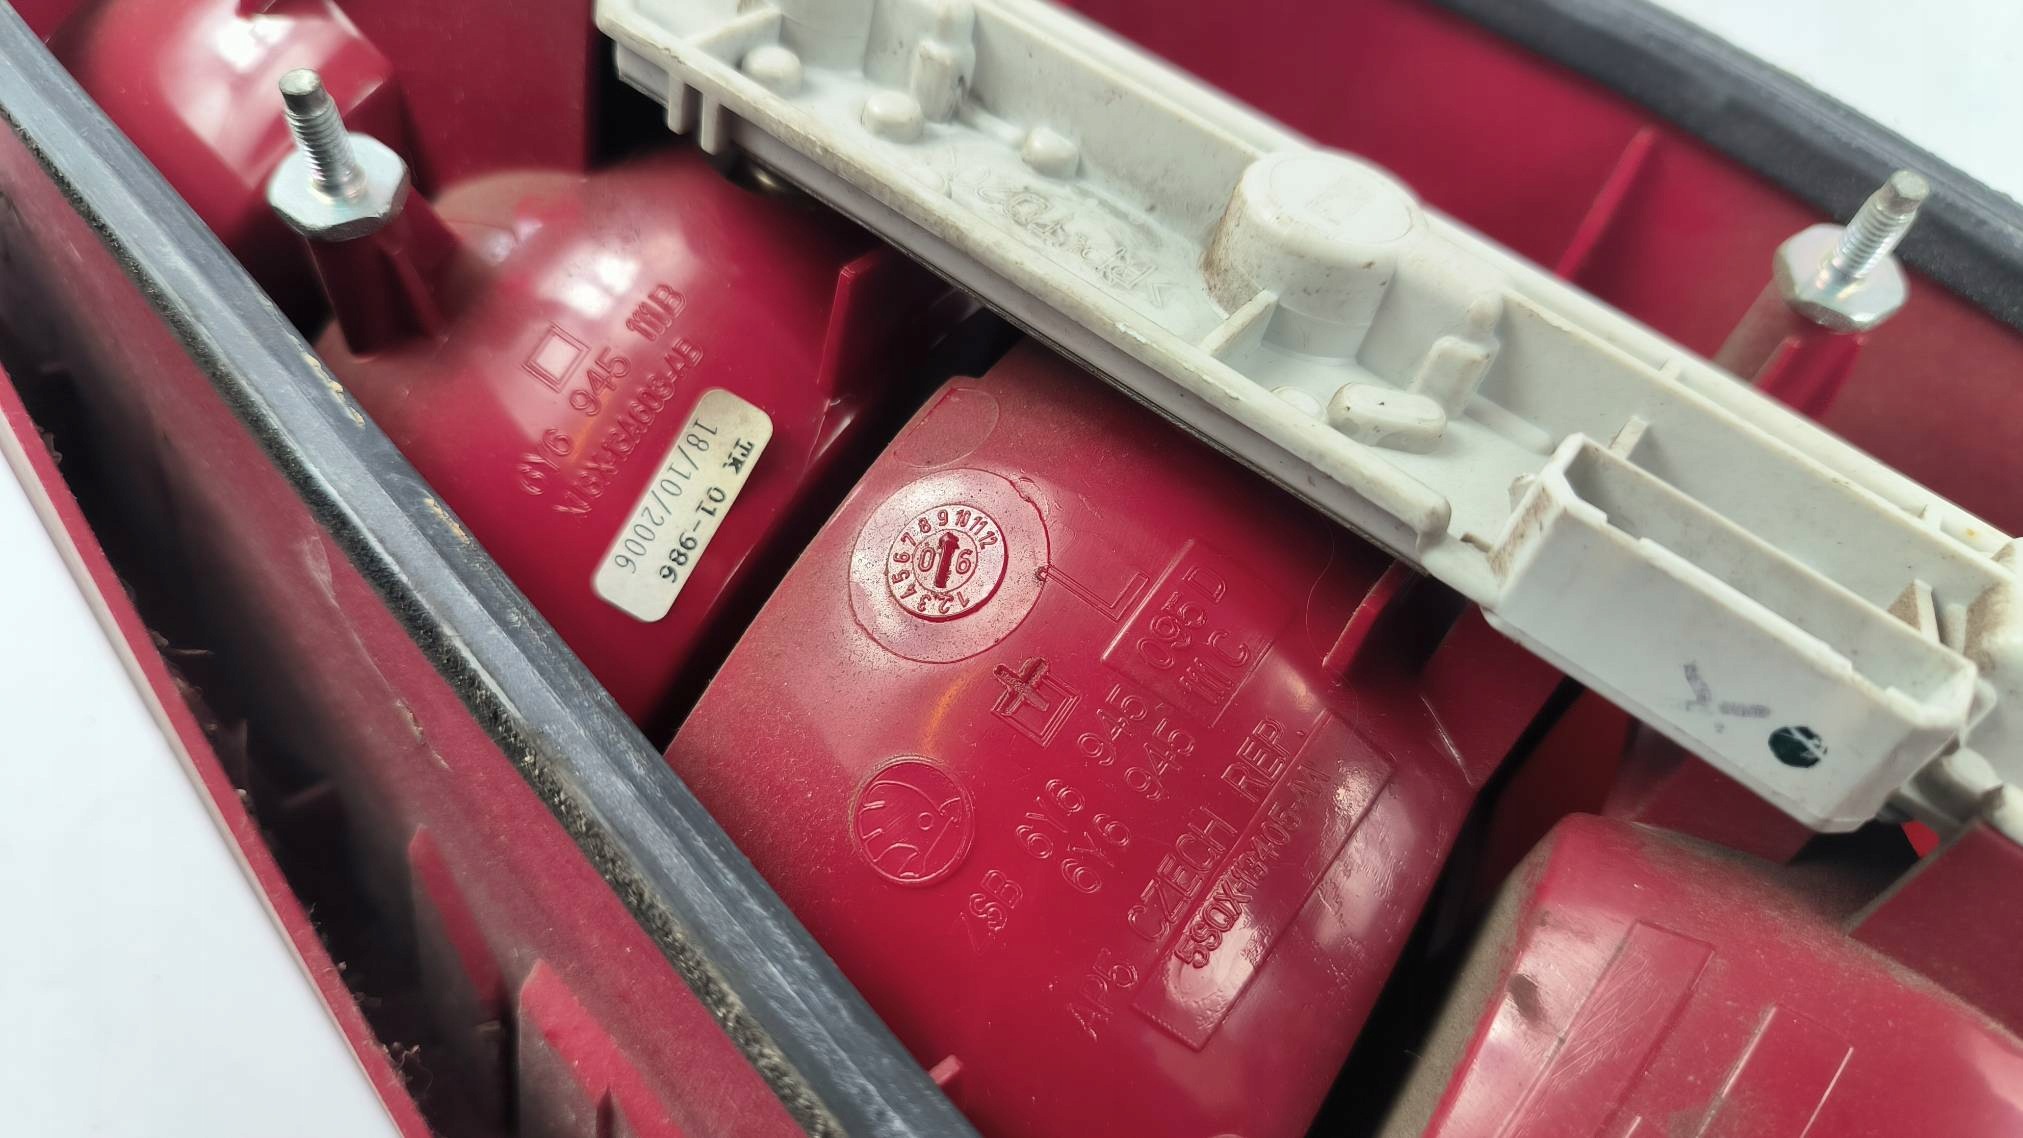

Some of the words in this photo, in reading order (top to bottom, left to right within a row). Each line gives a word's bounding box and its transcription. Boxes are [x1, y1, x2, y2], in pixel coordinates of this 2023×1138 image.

[569, 347, 632, 416] 945
[722, 437, 755, 476] TK
[614, 417, 719, 574] 18/10/2006
[919, 518, 931, 533] 8
[938, 510, 949, 526] 9
[955, 510, 970, 527] 10
[970, 516, 987, 531] 11
[659, 486, 726, 584] 01-986
[901, 532, 916, 546] 7
[980, 531, 998, 549] 12
[894, 552, 910, 563] 6
[956, 549, 972, 574] 6
[893, 570, 909, 583] 5
[901, 585, 916, 599] 4
[957, 592, 969, 607] 1
[1043, 562, 1150, 624] L
[919, 595, 931, 611] 3
[935, 593, 953, 613] 2
[1015, 778, 1085, 860] 6Y6
[1077, 683, 1148, 766] 945
[1061, 813, 1131, 895] 6Y6
[1123, 717, 1195, 800] 945
[1127, 805, 1238, 941] CZECH
[1221, 717, 1305, 803] REP.
